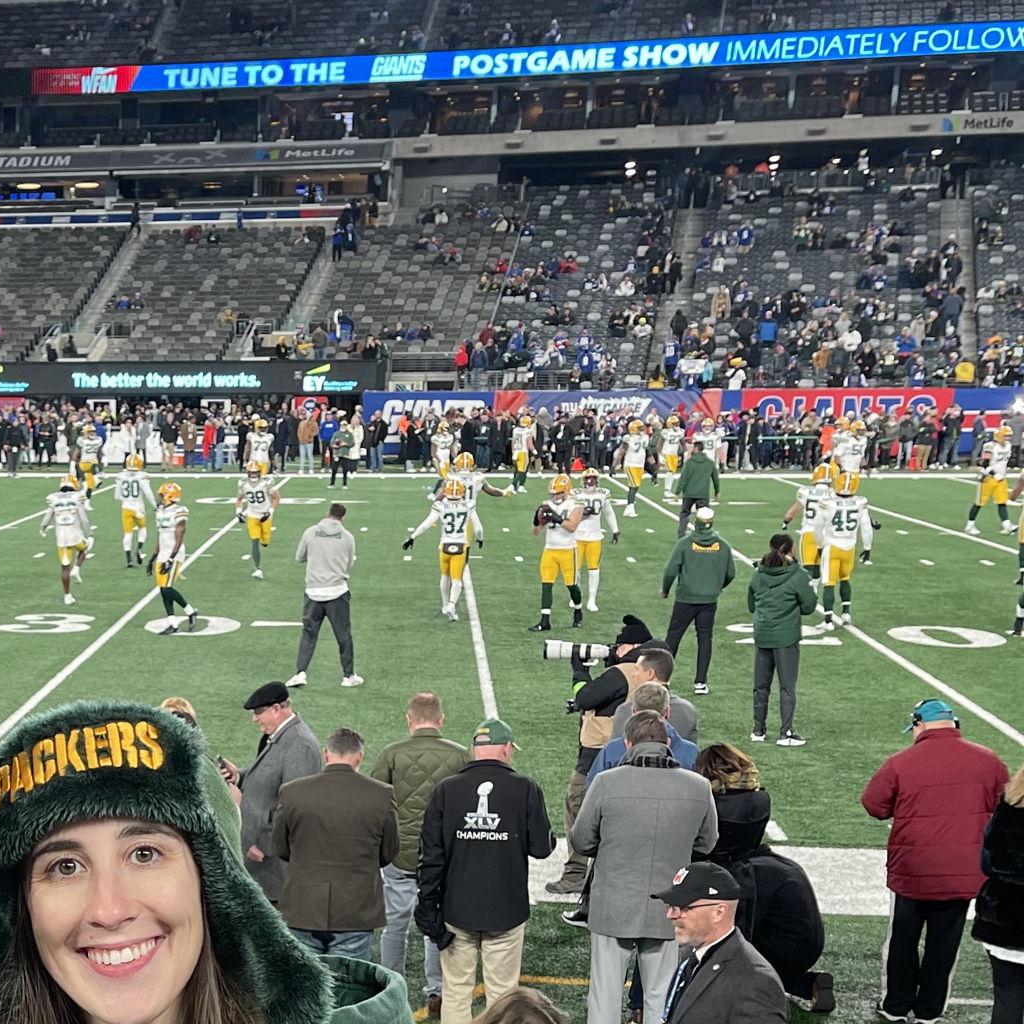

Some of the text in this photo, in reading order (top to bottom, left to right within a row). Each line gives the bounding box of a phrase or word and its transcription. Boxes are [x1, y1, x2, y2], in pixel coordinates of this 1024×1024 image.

[453, 48, 616, 77] POSTGAME
[622, 42, 720, 69] SHOW
[726, 32, 909, 62] IMMEDIATELY
[372, 54, 427, 78] GIANTS
[163, 63, 346, 89] TUNE TO THE
[963, 117, 1014, 130] MetLife
[285, 148, 356, 159] MetLife
[71, 372, 262, 388] The better the world works.
[121, 480, 139, 498] 30
[443, 512, 468, 534] 37
[831, 510, 859, 532] 45
[464, 817, 501, 830] XLV
[456, 830, 509, 841] CHAMPIONS
